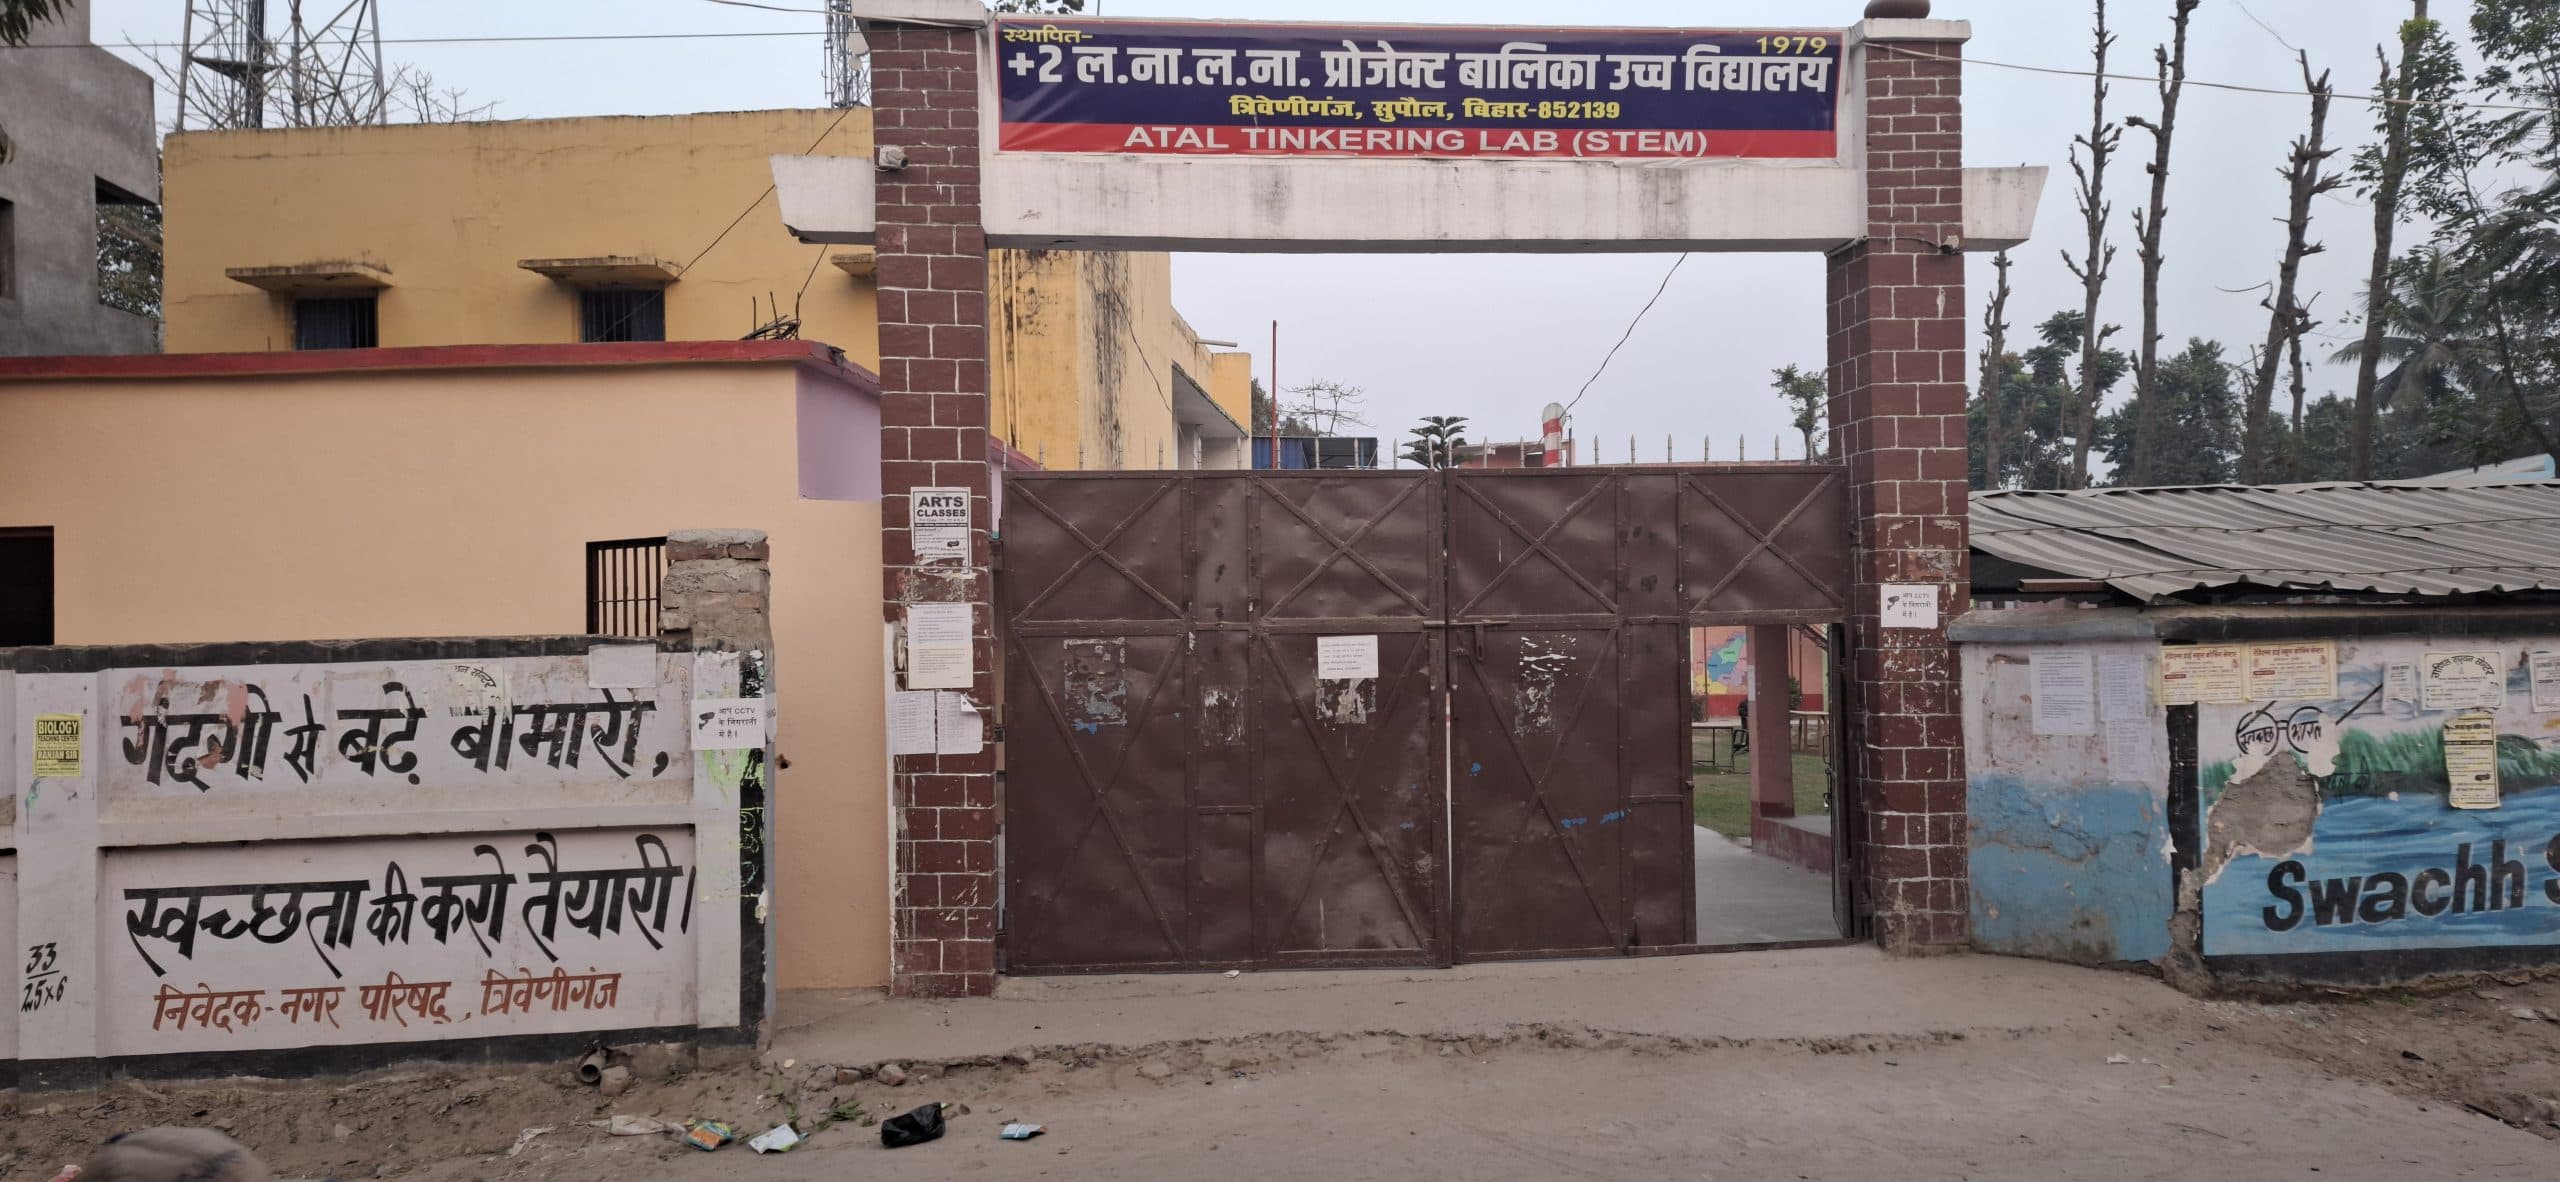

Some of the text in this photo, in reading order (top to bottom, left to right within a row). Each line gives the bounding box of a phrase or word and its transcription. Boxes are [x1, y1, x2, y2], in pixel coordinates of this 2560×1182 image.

[1003, 25, 1093, 43] स्थापित-
[1756, 36, 1827, 55] 1979
[1008, 44, 1062, 83] +2
[1320, 40, 1449, 88] प्रोजेक्ट
[1455, 41, 1600, 90] बालिका
[1605, 54, 1676, 91] उच्च
[1682, 43, 1832, 92] विद्यालय
[1228, 94, 1621, 123] त्रिवेणीगंज, सुपौल, बिहार-852139
[1124, 127, 1708, 157] ATAL TINKERING LAB (STEM)
[917, 509, 966, 517] CLASSES
[918, 496, 964, 508] ARTS
[38, 721, 78, 735] BIOLOGY
[283, 693, 326, 784] से
[2262, 839, 2526, 933] Swachh
[123, 879, 371, 980] स्वच्छता
[366, 861, 419, 946] की
[420, 844, 518, 959] करो
[25, 942, 57, 974] 33
[480, 966, 622, 1015] त्रिवेणीगंज
